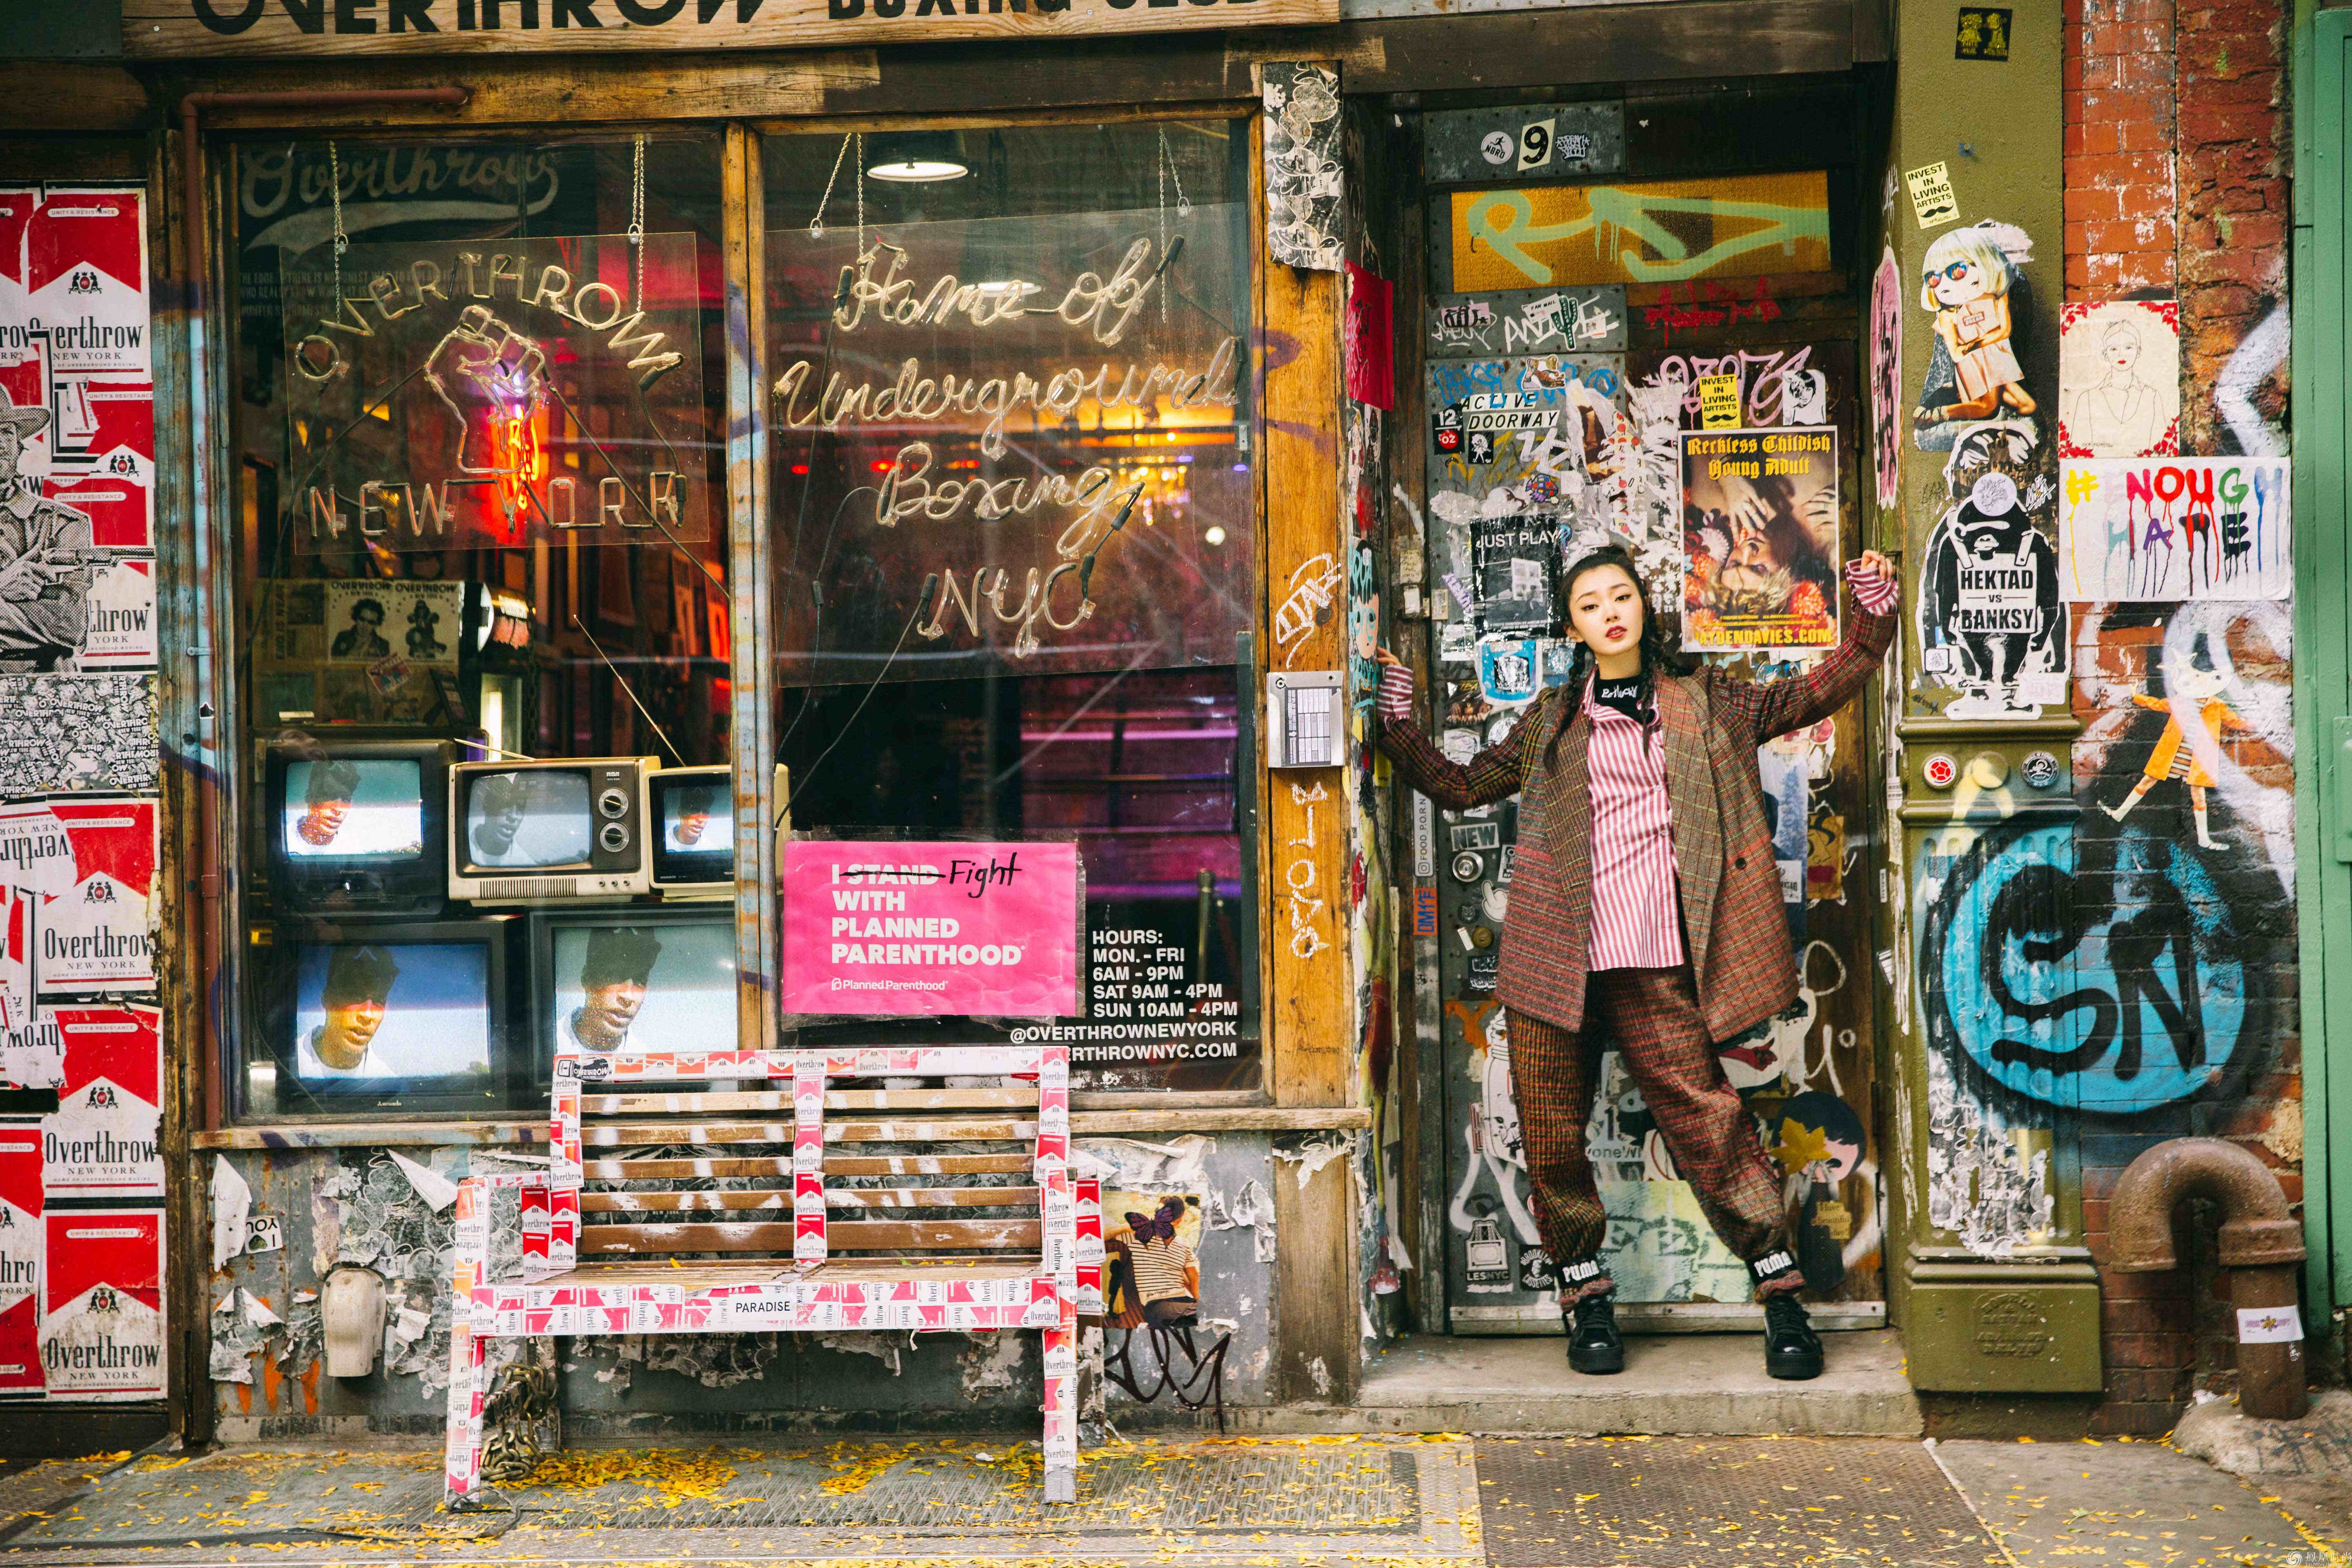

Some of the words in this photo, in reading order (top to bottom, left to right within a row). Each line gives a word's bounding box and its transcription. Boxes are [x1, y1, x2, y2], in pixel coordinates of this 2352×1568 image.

[1522, 126, 1549, 164] 9
[1908, 164, 1943, 181] INVEST
[1923, 177, 1935, 187] IN
[1913, 184, 1950, 200] LIVING
[1916, 193, 1952, 209] ARTISTS
[294, 252, 686, 381] OVERTHROW
[87, 352, 122, 360] YORK
[1701, 376, 1735, 385] INVEST
[773, 335, 1240, 457] Underground
[1713, 385, 1724, 394] IN
[1702, 394, 1736, 404] LIVING
[1703, 404, 1737, 412] ARTISTS
[1468, 411, 1558, 429] DOORWAY
[1687, 437, 1758, 455] Reckless
[1762, 434, 1831, 454] Childish
[1708, 460, 1760, 480] Young
[1765, 457, 1811, 476] Adult
[308, 480, 449, 539] NEW
[496, 471, 683, 533] YORK
[876, 441, 1146, 555] Boxing
[1476, 533, 1516, 548] JUST
[1519, 530, 1557, 546] PLAY
[1960, 570, 2034, 590] HEKTAD
[1989, 594, 2002, 603] VS
[1961, 608, 2036, 631] BANKSY
[94, 635, 129, 644] YORK
[1452, 824, 1498, 849] NEW
[949, 852, 1023, 899] Fight
[832, 891, 905, 911] WITH
[832, 917, 960, 938] PLANNED
[1092, 930, 1163, 945] HOURS:
[832, 944, 1023, 966] PARENTHOOD
[1093, 948, 1140, 963] MON.
[1156, 947, 1185, 962] FRI
[101, 961, 136, 969] YORK
[1092, 966, 1130, 981] 6AM
[1146, 965, 1184, 981] 9PM
[843, 980, 884, 990] Planned
[885, 980, 946, 991] Parenthood
[1093, 985, 1127, 999] SAT
[1131, 984, 1169, 998] 9AM
[1185, 983, 1223, 998] 4PM
[1093, 1003, 1132, 1018] SUN
[1137, 1002, 1184, 1017] 10AM
[1200, 1002, 1238, 1016] 4PM
[1009, 1021, 1237, 1044] @OVERTHROWNEWYORK
[46, 1131, 156, 1164] Overthrow
[103, 1166, 137, 1174] YORK
[552, 1172, 581, 1182] Overthrow
[1562, 1259, 1600, 1284] PUMA
[1754, 1251, 1793, 1278] PUMA
[1522, 1274, 1554, 1290] CASSETTES
[735, 1301, 791, 1313] PARADISE
[47, 1334, 160, 1370] Overthrow
[104, 1371, 139, 1379] YORK
